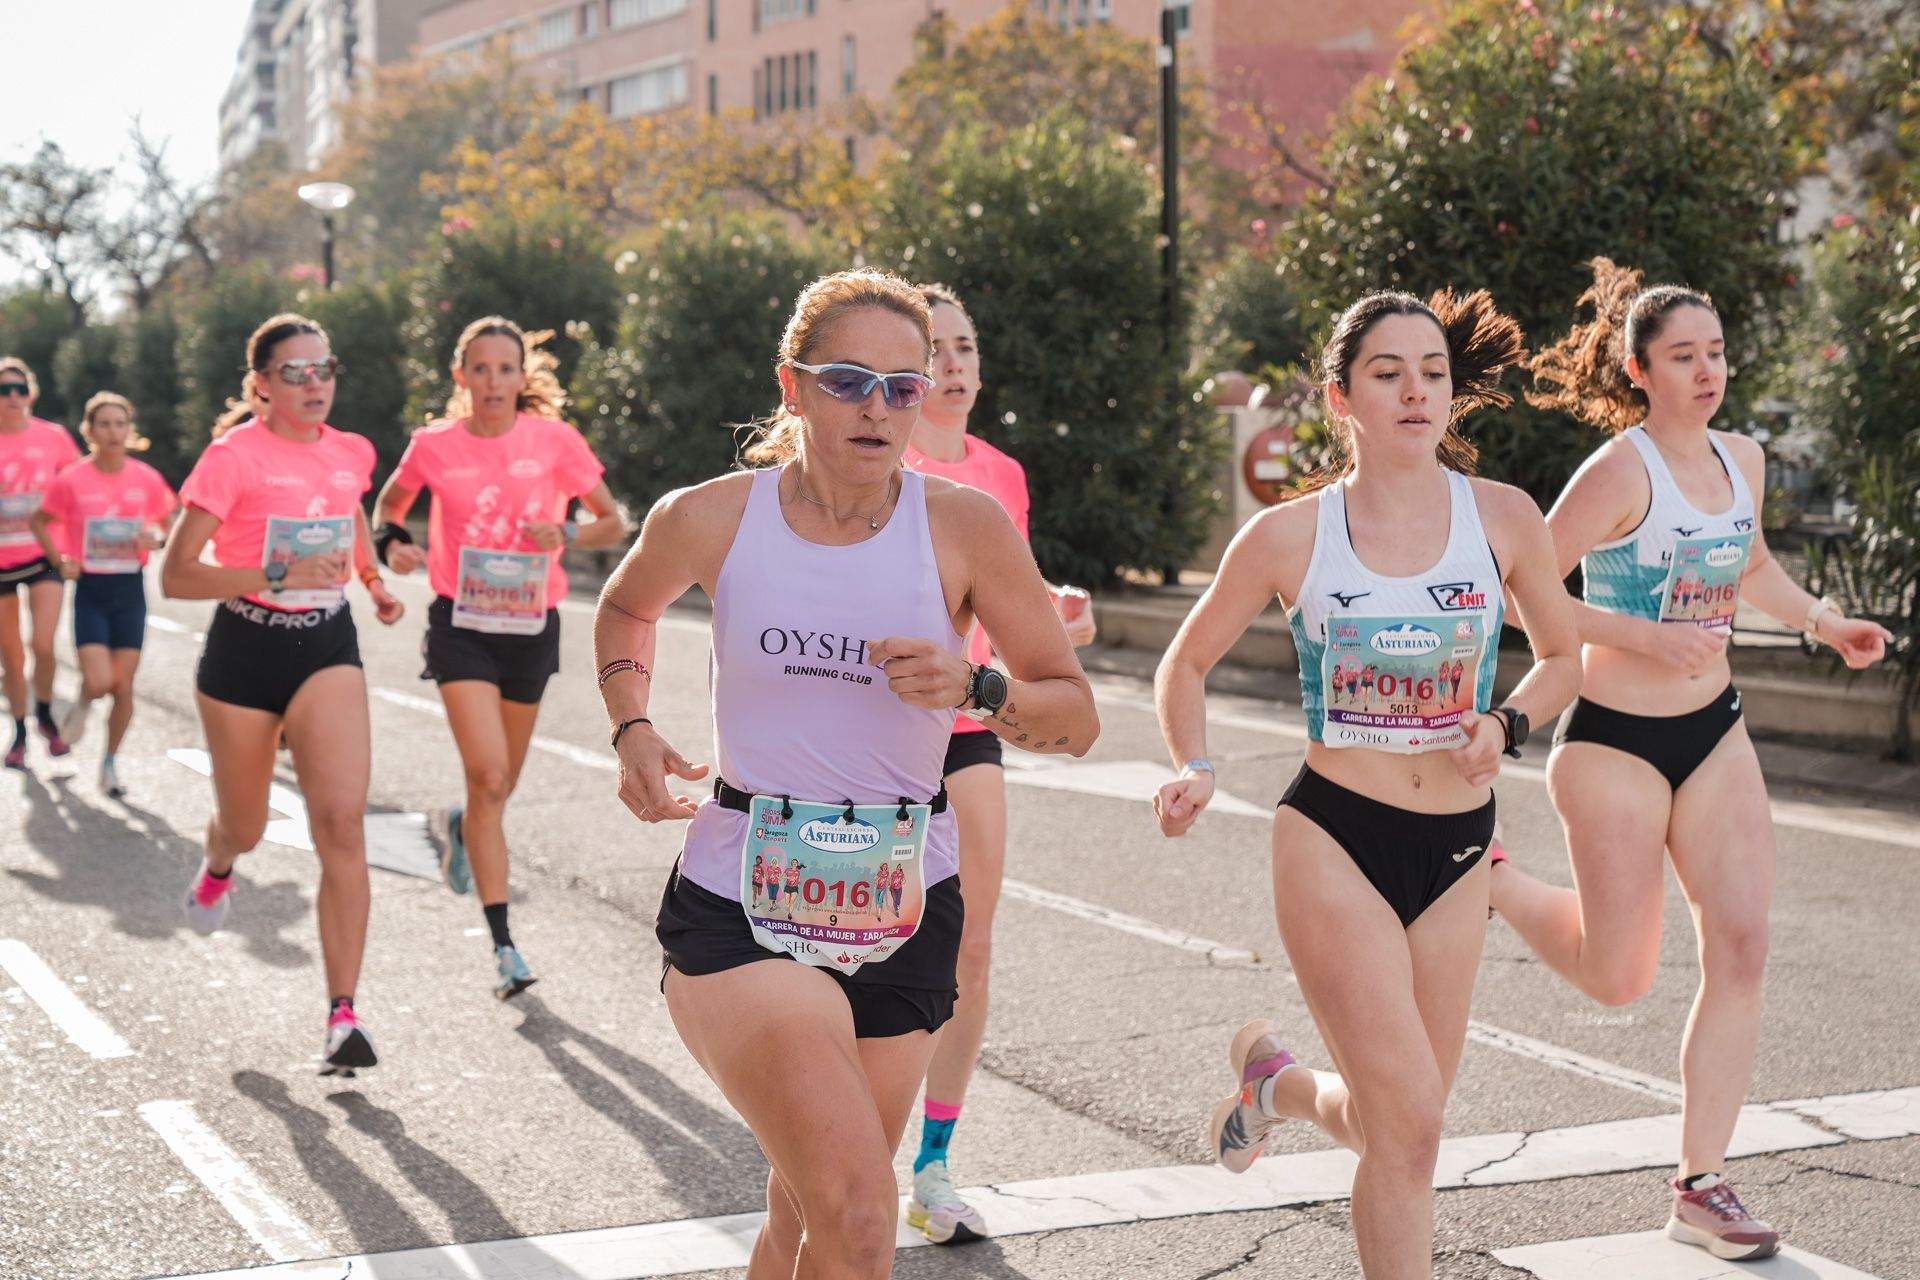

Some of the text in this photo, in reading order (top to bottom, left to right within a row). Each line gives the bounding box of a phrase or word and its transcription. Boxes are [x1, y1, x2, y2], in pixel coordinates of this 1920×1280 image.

[1703, 583, 1734, 604] 016
[268, 610, 320, 629] PRO
[759, 627, 868, 665] OYSH
[1375, 635, 1437, 649] ASTURIANA
[784, 665, 873, 685] RUNNING CLUB
[1377, 674, 1434, 700] 016
[1390, 704, 1418, 714] 5013
[1341, 713, 1373, 724] CARRERA
[1375, 716, 1385, 725] DE
[1386, 717, 1396, 726] LA
[1398, 716, 1423, 726] MUJER
[1340, 729, 1389, 744] OYSHO
[1421, 732, 1462, 745] Santander
[804, 825, 875, 844] ASTURIANA
[802, 878, 871, 908] 016
[829, 915, 838, 926] 9
[762, 921, 798, 934] CARRERA
[800, 927, 811, 936] DE
[813, 928, 824, 937] LA
[826, 930, 856, 941] MUJER
